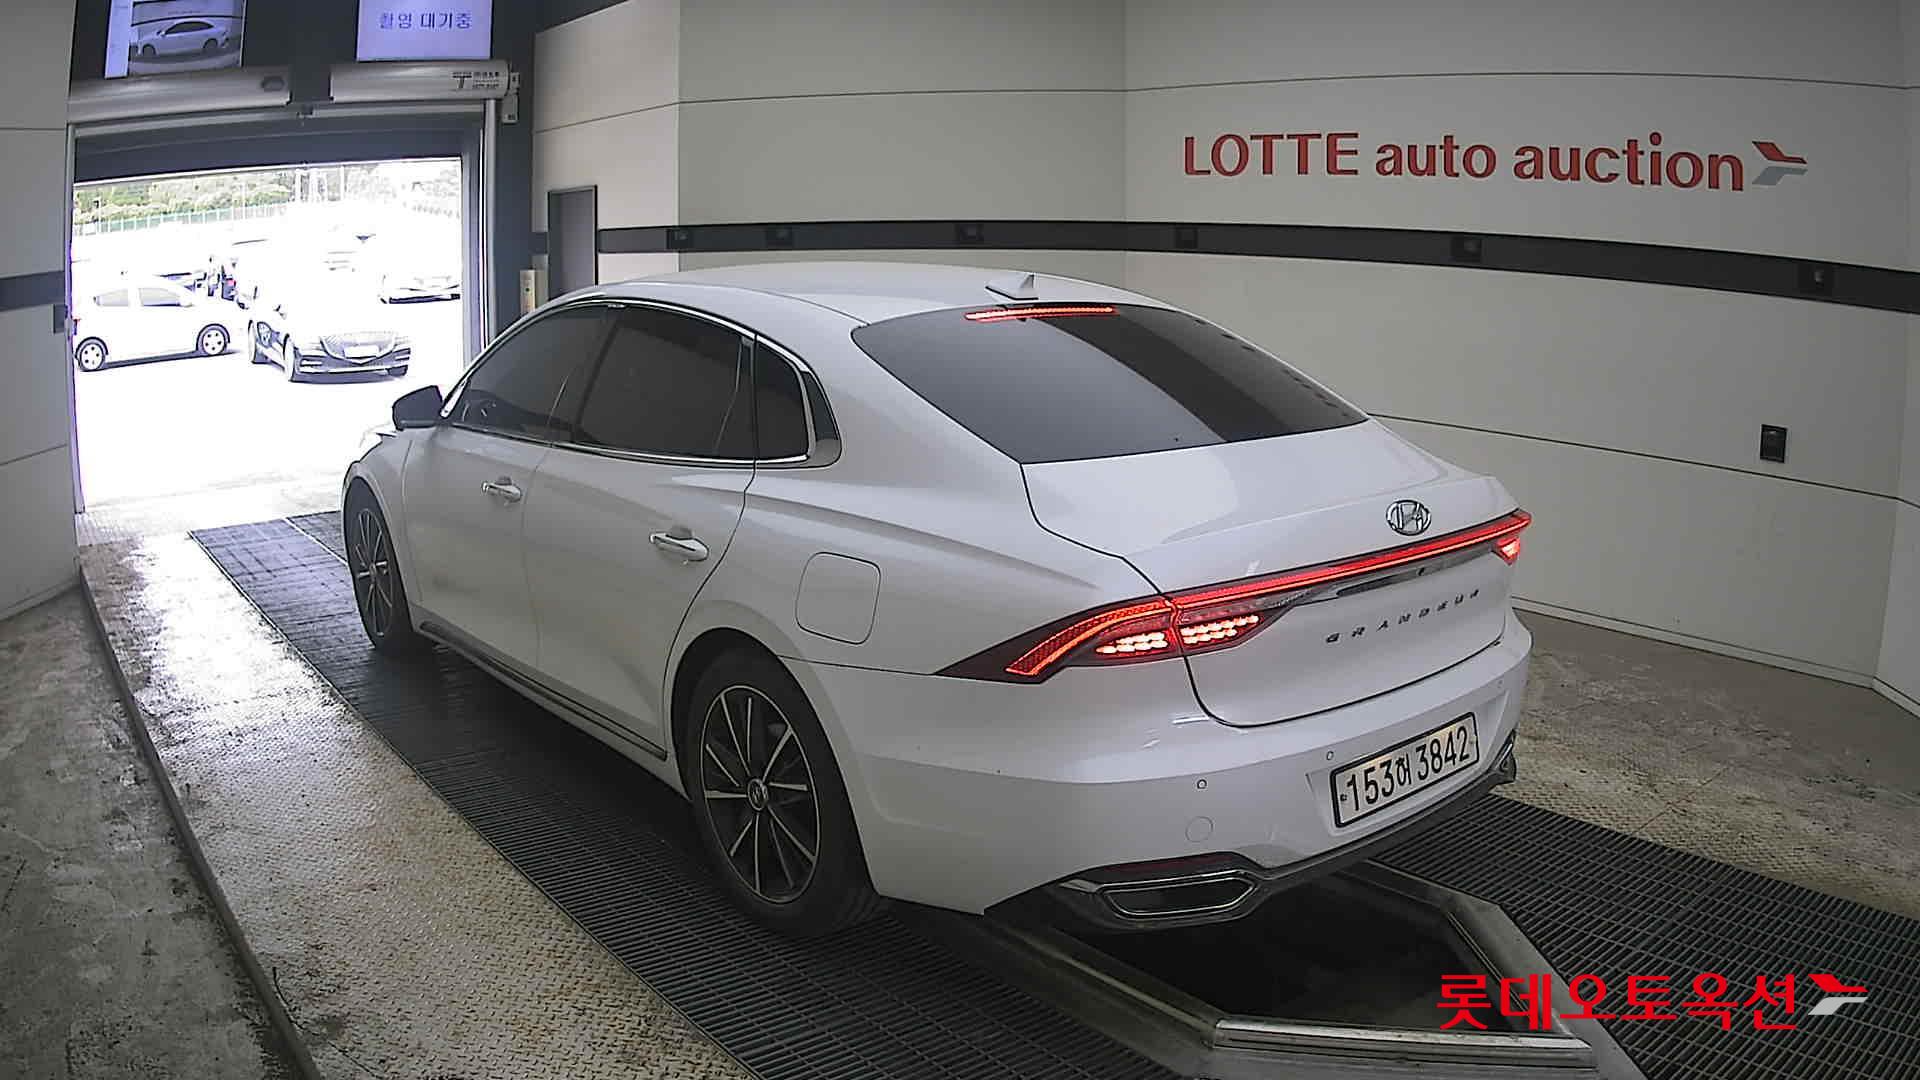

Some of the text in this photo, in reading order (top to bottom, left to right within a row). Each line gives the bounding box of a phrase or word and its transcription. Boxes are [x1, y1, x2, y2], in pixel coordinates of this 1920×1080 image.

[420, 11, 472, 30] 대기중
[1184, 131, 1744, 192] LOTTE auto auction
[1346, 725, 1470, 811] 153허 3842
